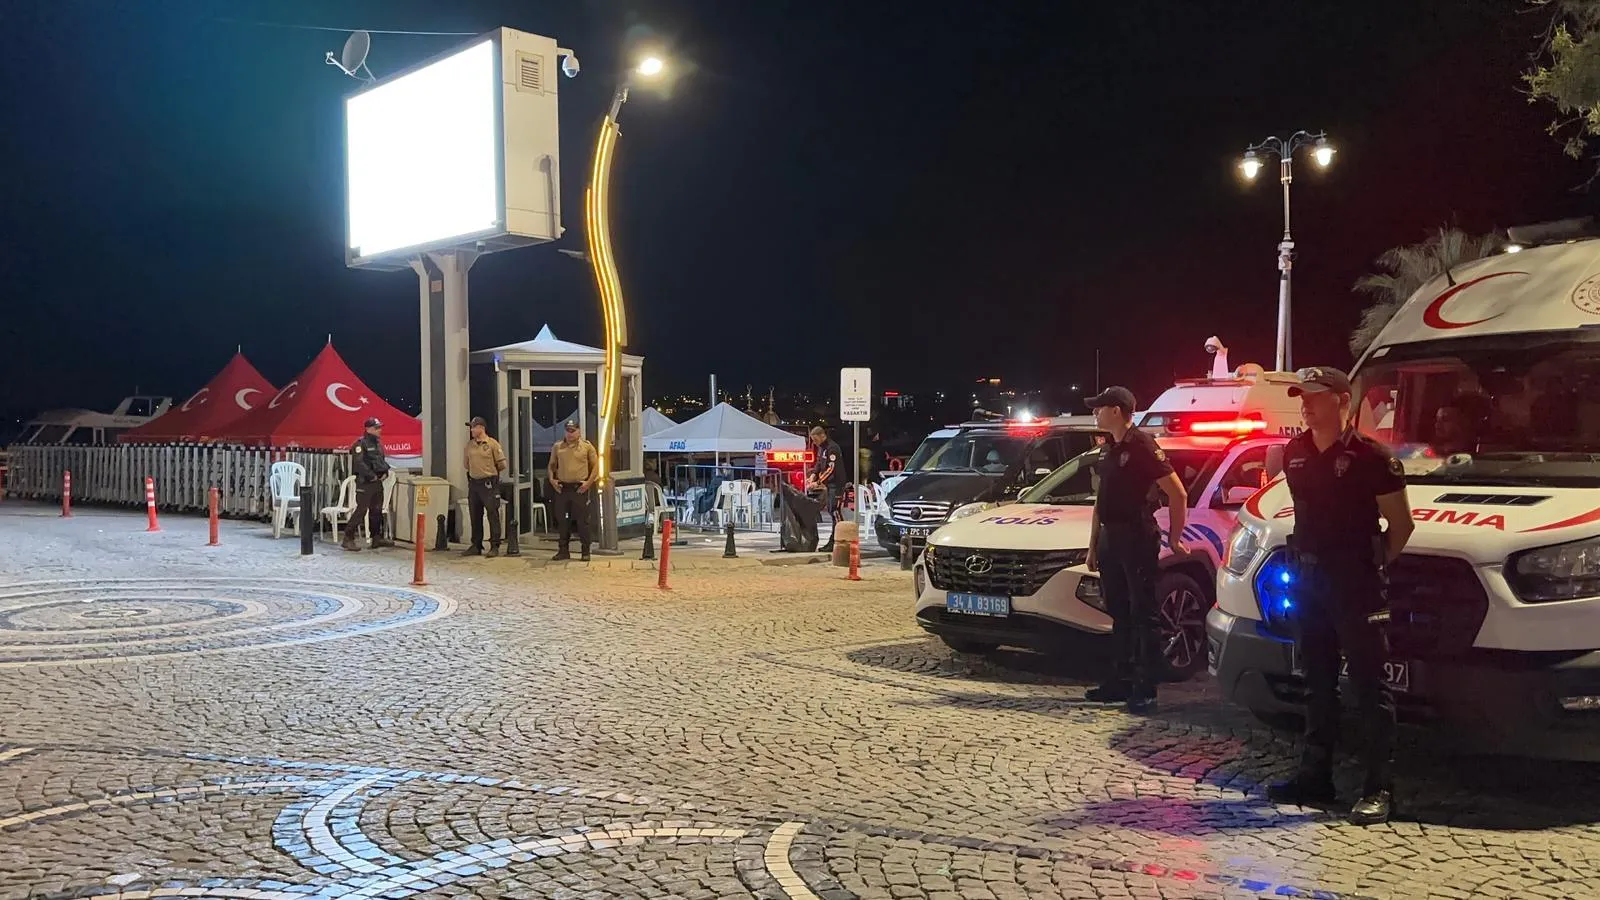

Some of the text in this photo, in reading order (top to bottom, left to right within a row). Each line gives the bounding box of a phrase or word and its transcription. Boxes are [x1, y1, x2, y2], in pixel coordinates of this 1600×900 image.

[669, 441, 685, 450] AFAD
[753, 441, 772, 450] AFAD
[953, 595, 1007, 612] 34 A 83169
